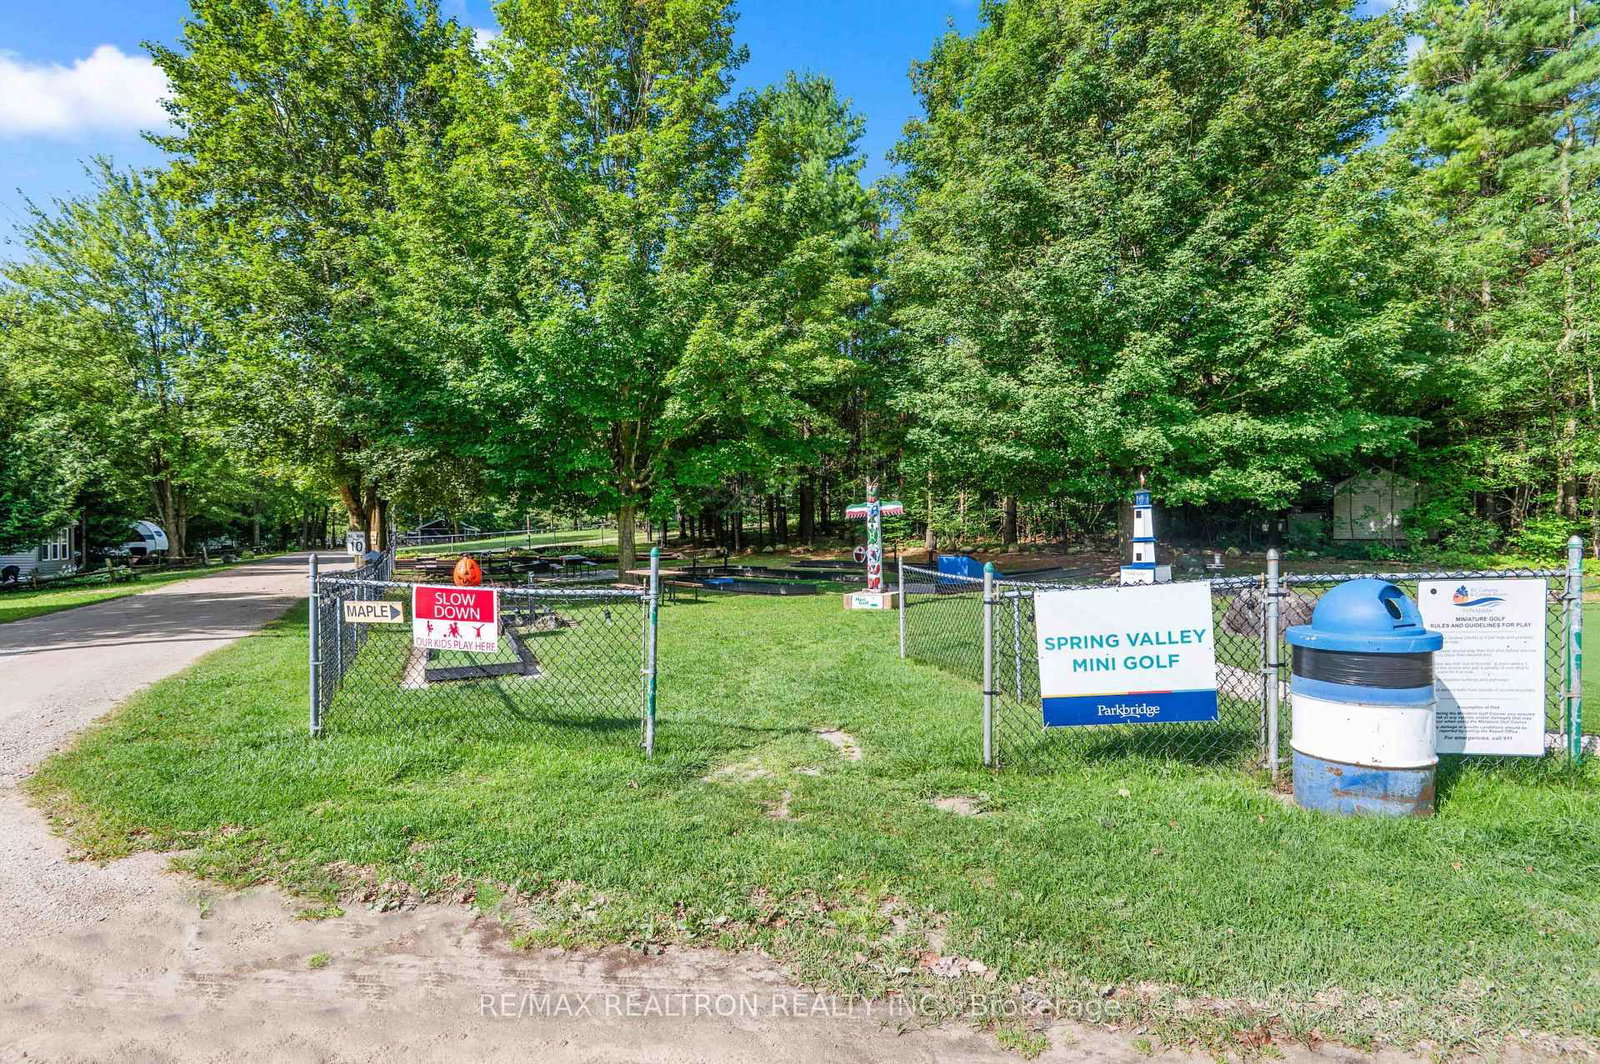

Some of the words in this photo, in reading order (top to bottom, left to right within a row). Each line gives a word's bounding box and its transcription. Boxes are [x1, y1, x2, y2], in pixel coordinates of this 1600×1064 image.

[351, 541, 363, 552] 10
[434, 591, 476, 606] SLOW
[346, 605, 389, 618] MAPLE
[434, 606, 480, 620] DOWN
[415, 637, 433, 647] OUR
[433, 639, 451, 649] KIDS
[453, 640, 472, 650] PLAY
[475, 642, 496, 652] HERE
[1044, 634, 1120, 651] SPRING
[1126, 629, 1206, 647] VALLEY
[1072, 657, 1116, 673] MINI
[1123, 654, 1180, 670] GOLF
[1097, 703, 1160, 718] Parkbridge
